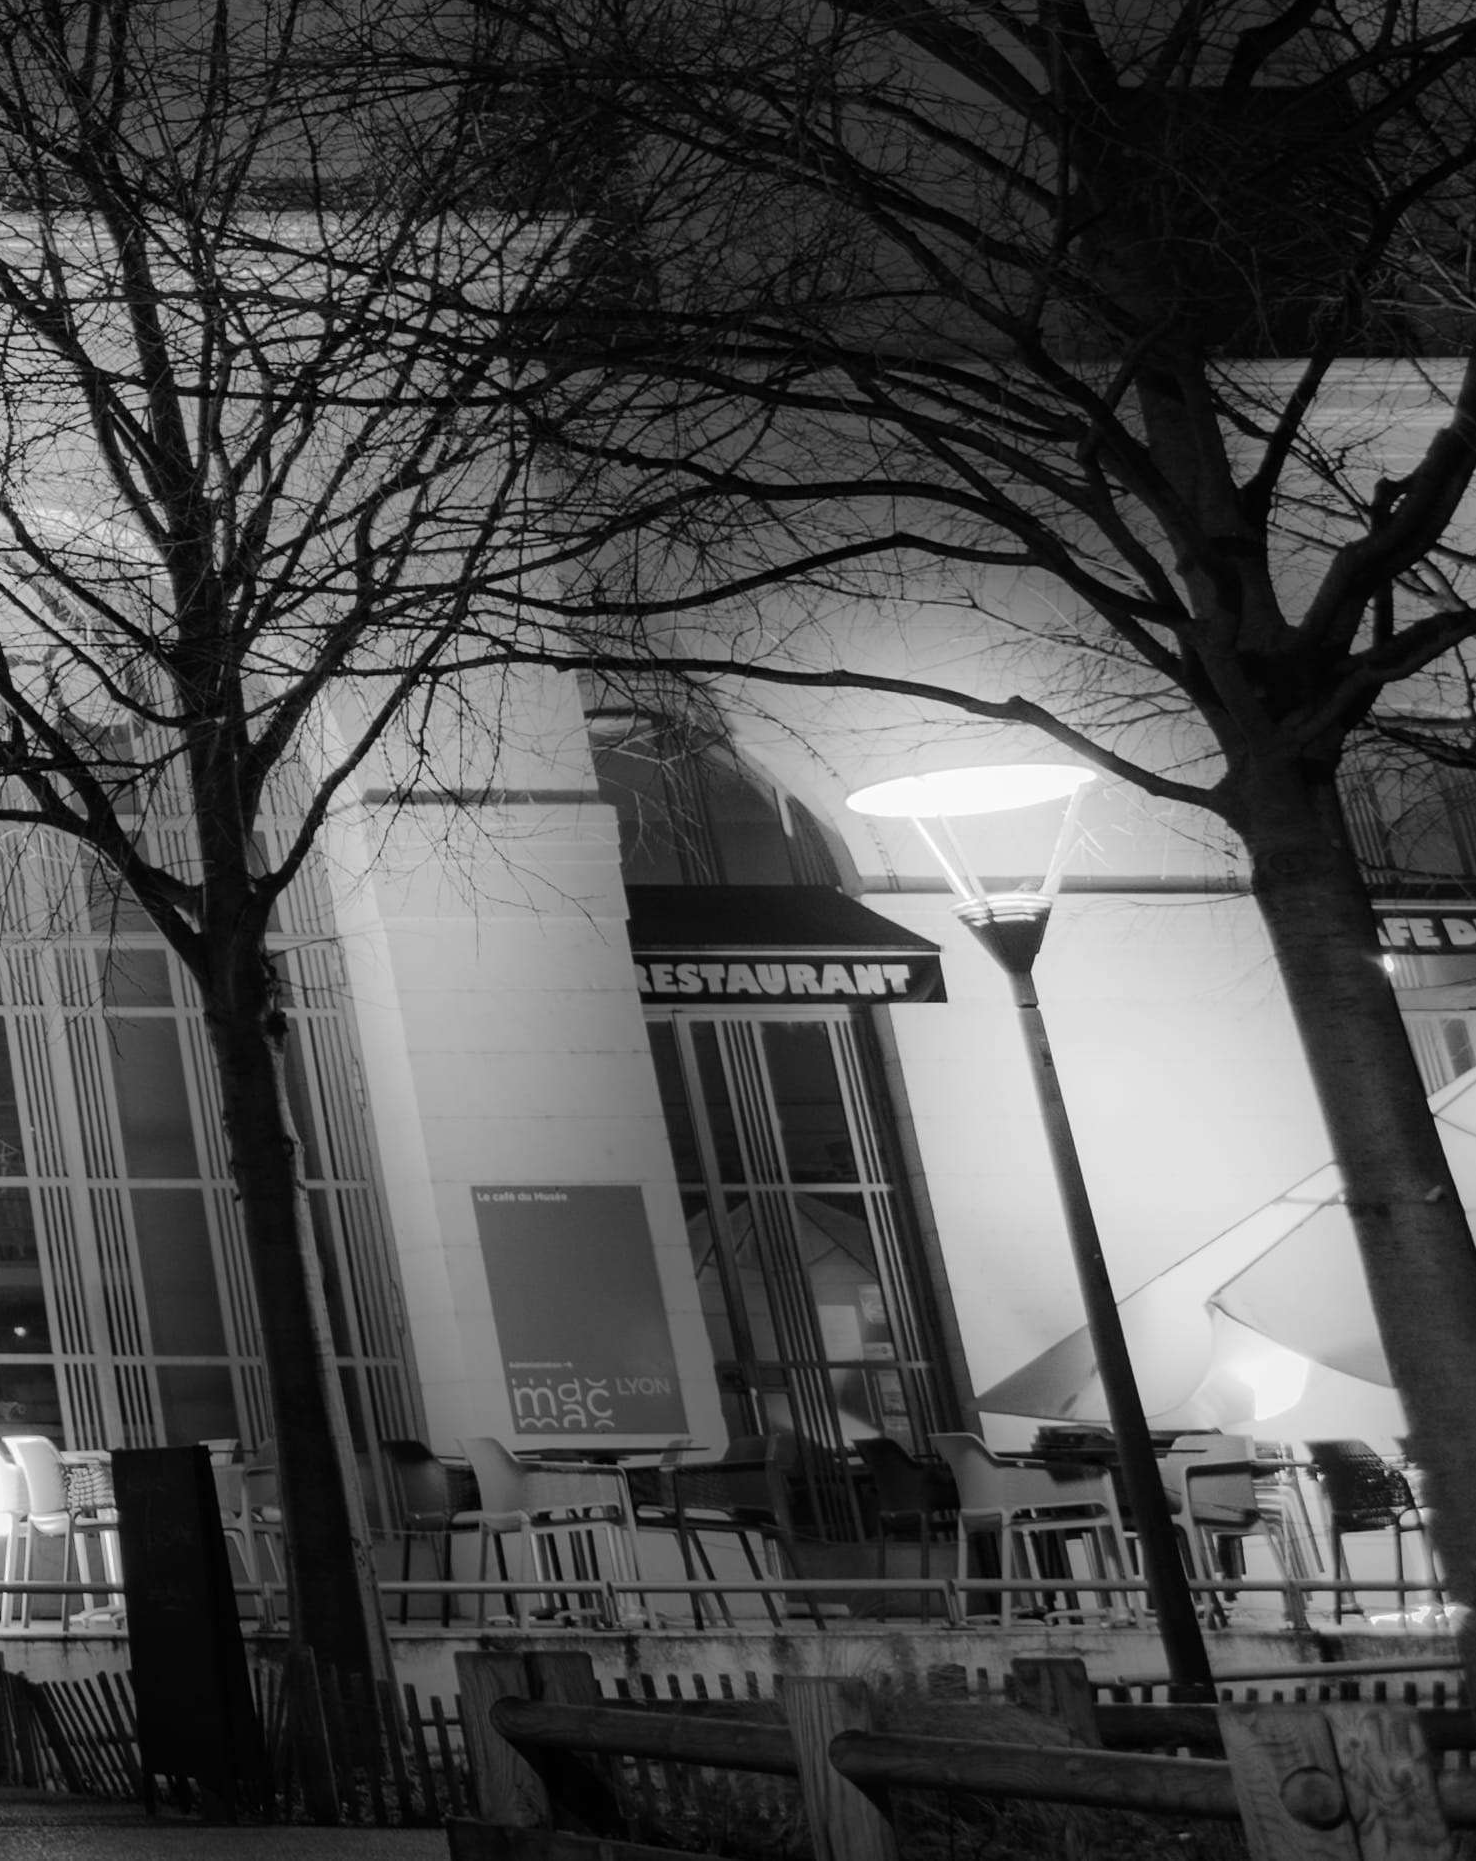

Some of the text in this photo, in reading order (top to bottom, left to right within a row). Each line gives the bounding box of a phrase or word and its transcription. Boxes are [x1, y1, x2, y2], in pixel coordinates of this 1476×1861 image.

[476, 1192, 491, 1201] Le
[517, 1192, 532, 1201] du
[615, 1377, 672, 1396] LYON
